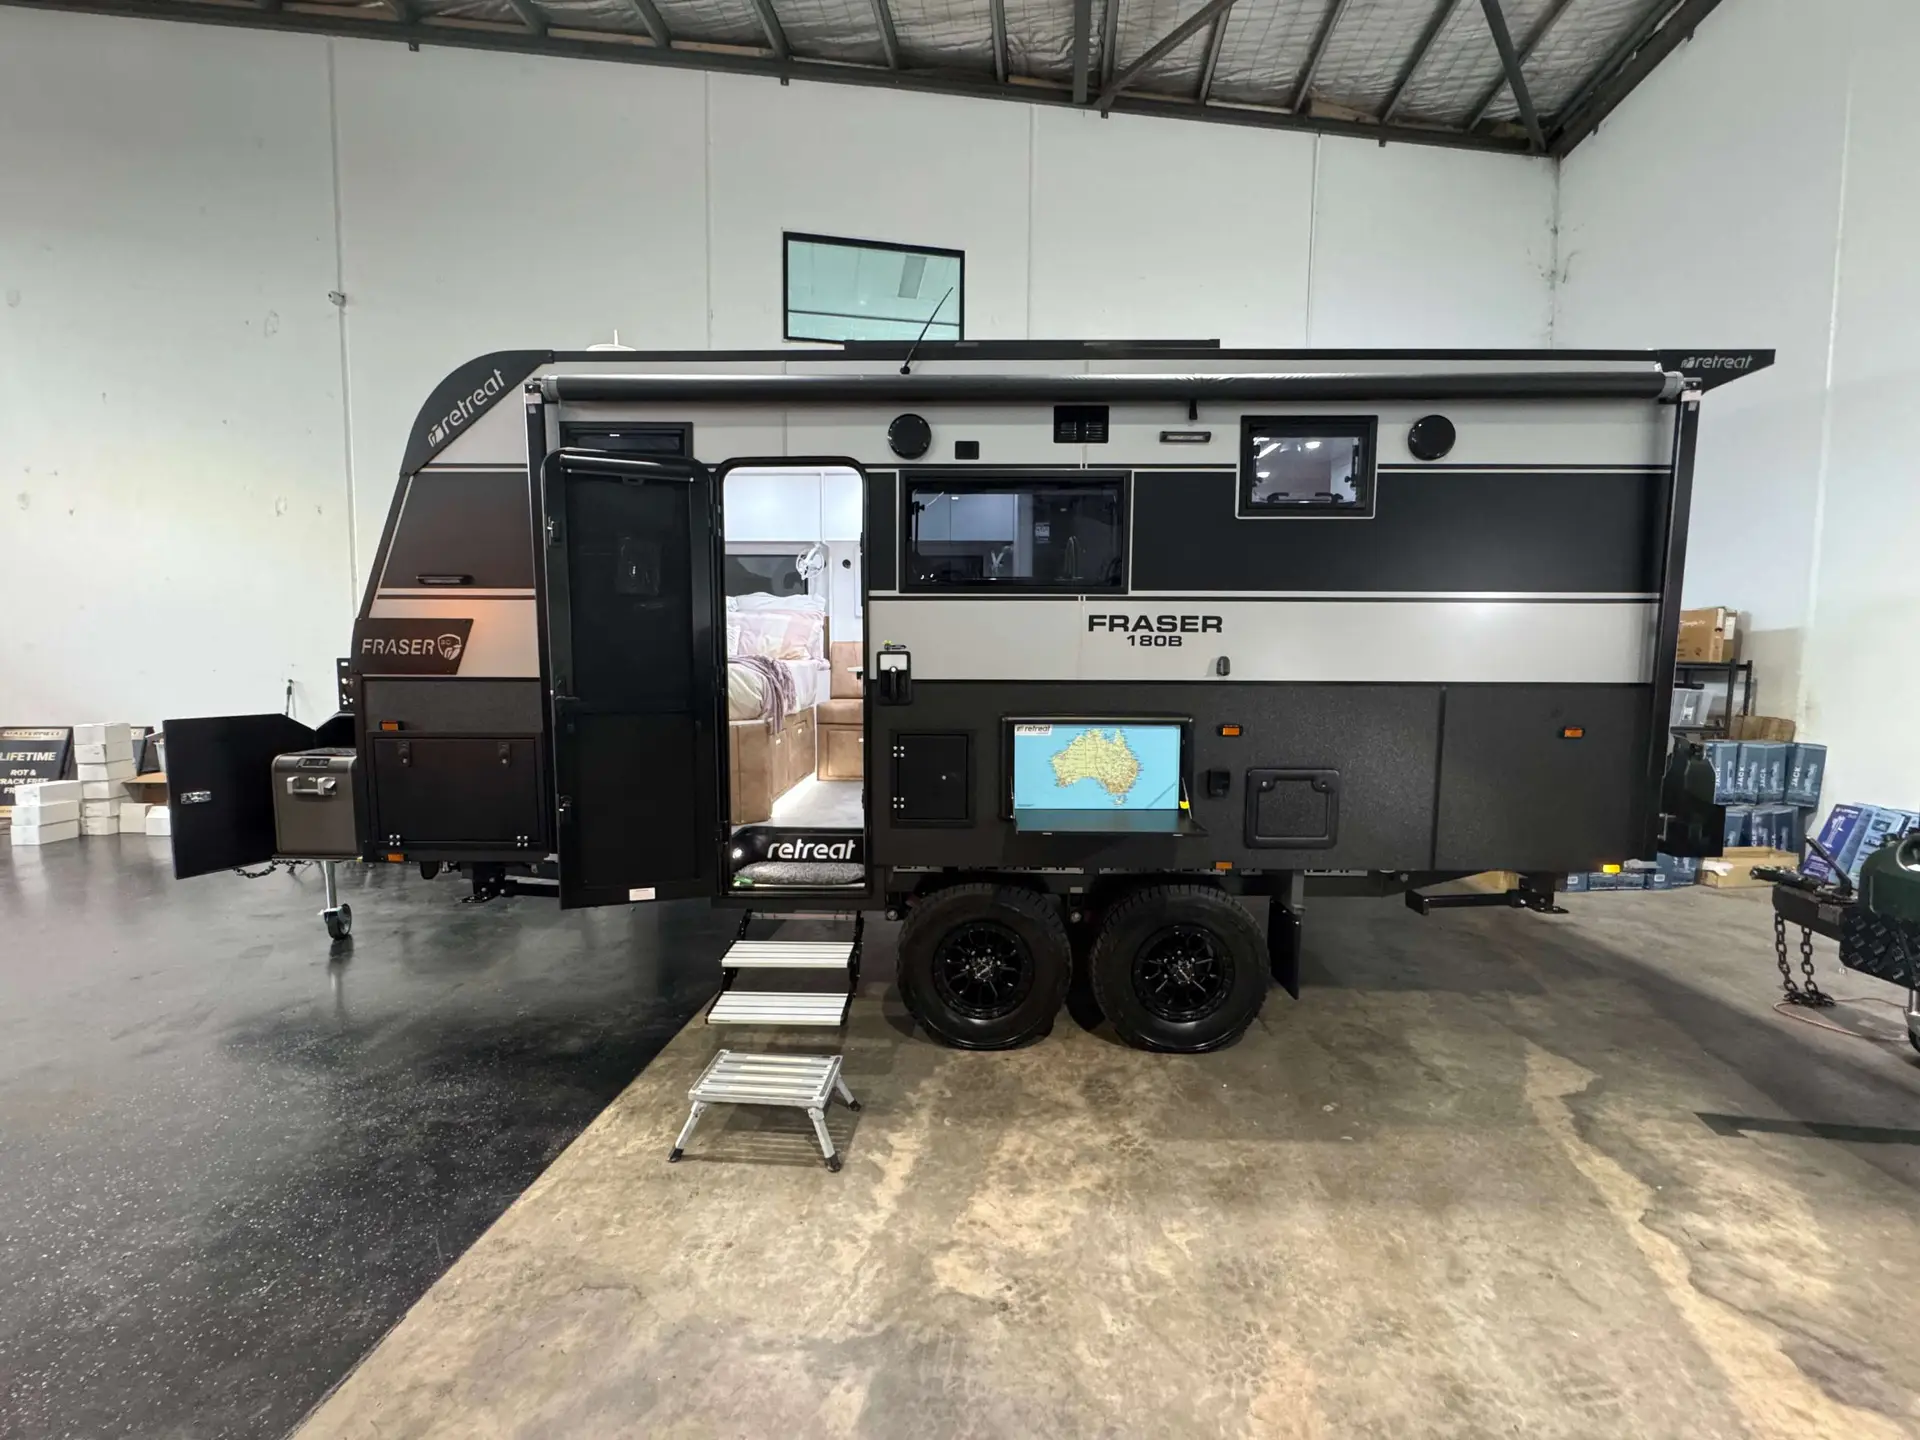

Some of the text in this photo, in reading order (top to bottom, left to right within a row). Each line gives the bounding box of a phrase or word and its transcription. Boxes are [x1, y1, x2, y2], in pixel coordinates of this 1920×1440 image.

[1694, 354, 1753, 369] retreat
[441, 368, 505, 434] retreat
[1088, 614, 1223, 633] FRASER
[361, 638, 435, 655] FRASER
[1127, 635, 1182, 647] 180B
[0, 751, 57, 761] LIFETIME
[10, 769, 29, 777] ROT
[1736, 766, 1746, 787] JACK
[1791, 766, 1801, 787] JACK
[767, 838, 856, 859] retreat
